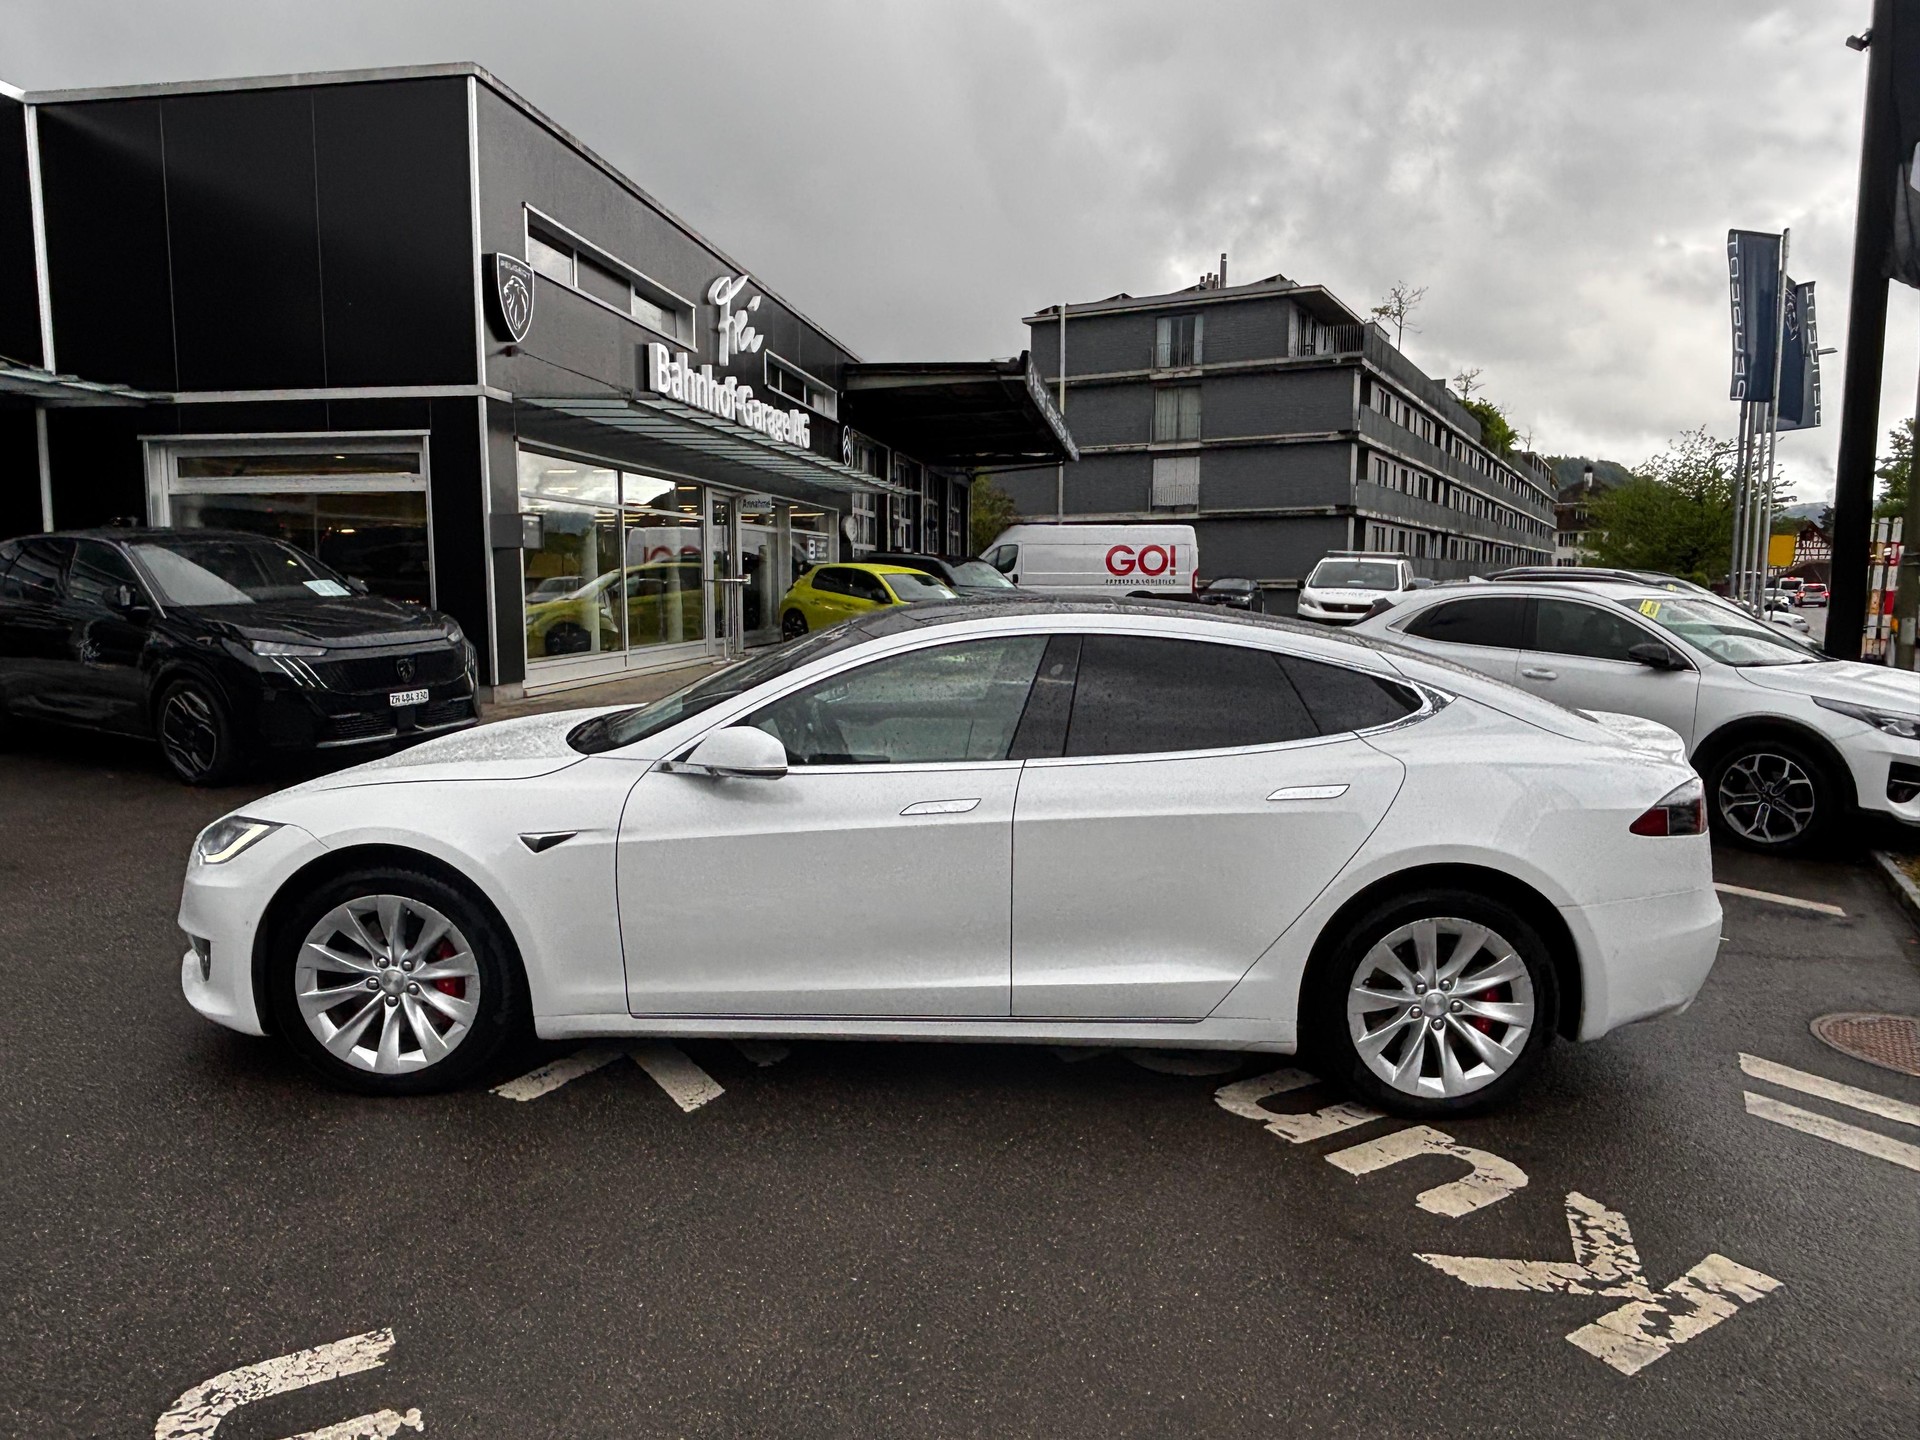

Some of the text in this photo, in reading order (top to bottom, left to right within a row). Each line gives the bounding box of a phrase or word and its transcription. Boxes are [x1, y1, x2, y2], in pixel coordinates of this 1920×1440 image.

[1805, 286, 1821, 426] PEUGEOT
[789, 409, 810, 448] AG
[1105, 544, 1177, 577] GO!
